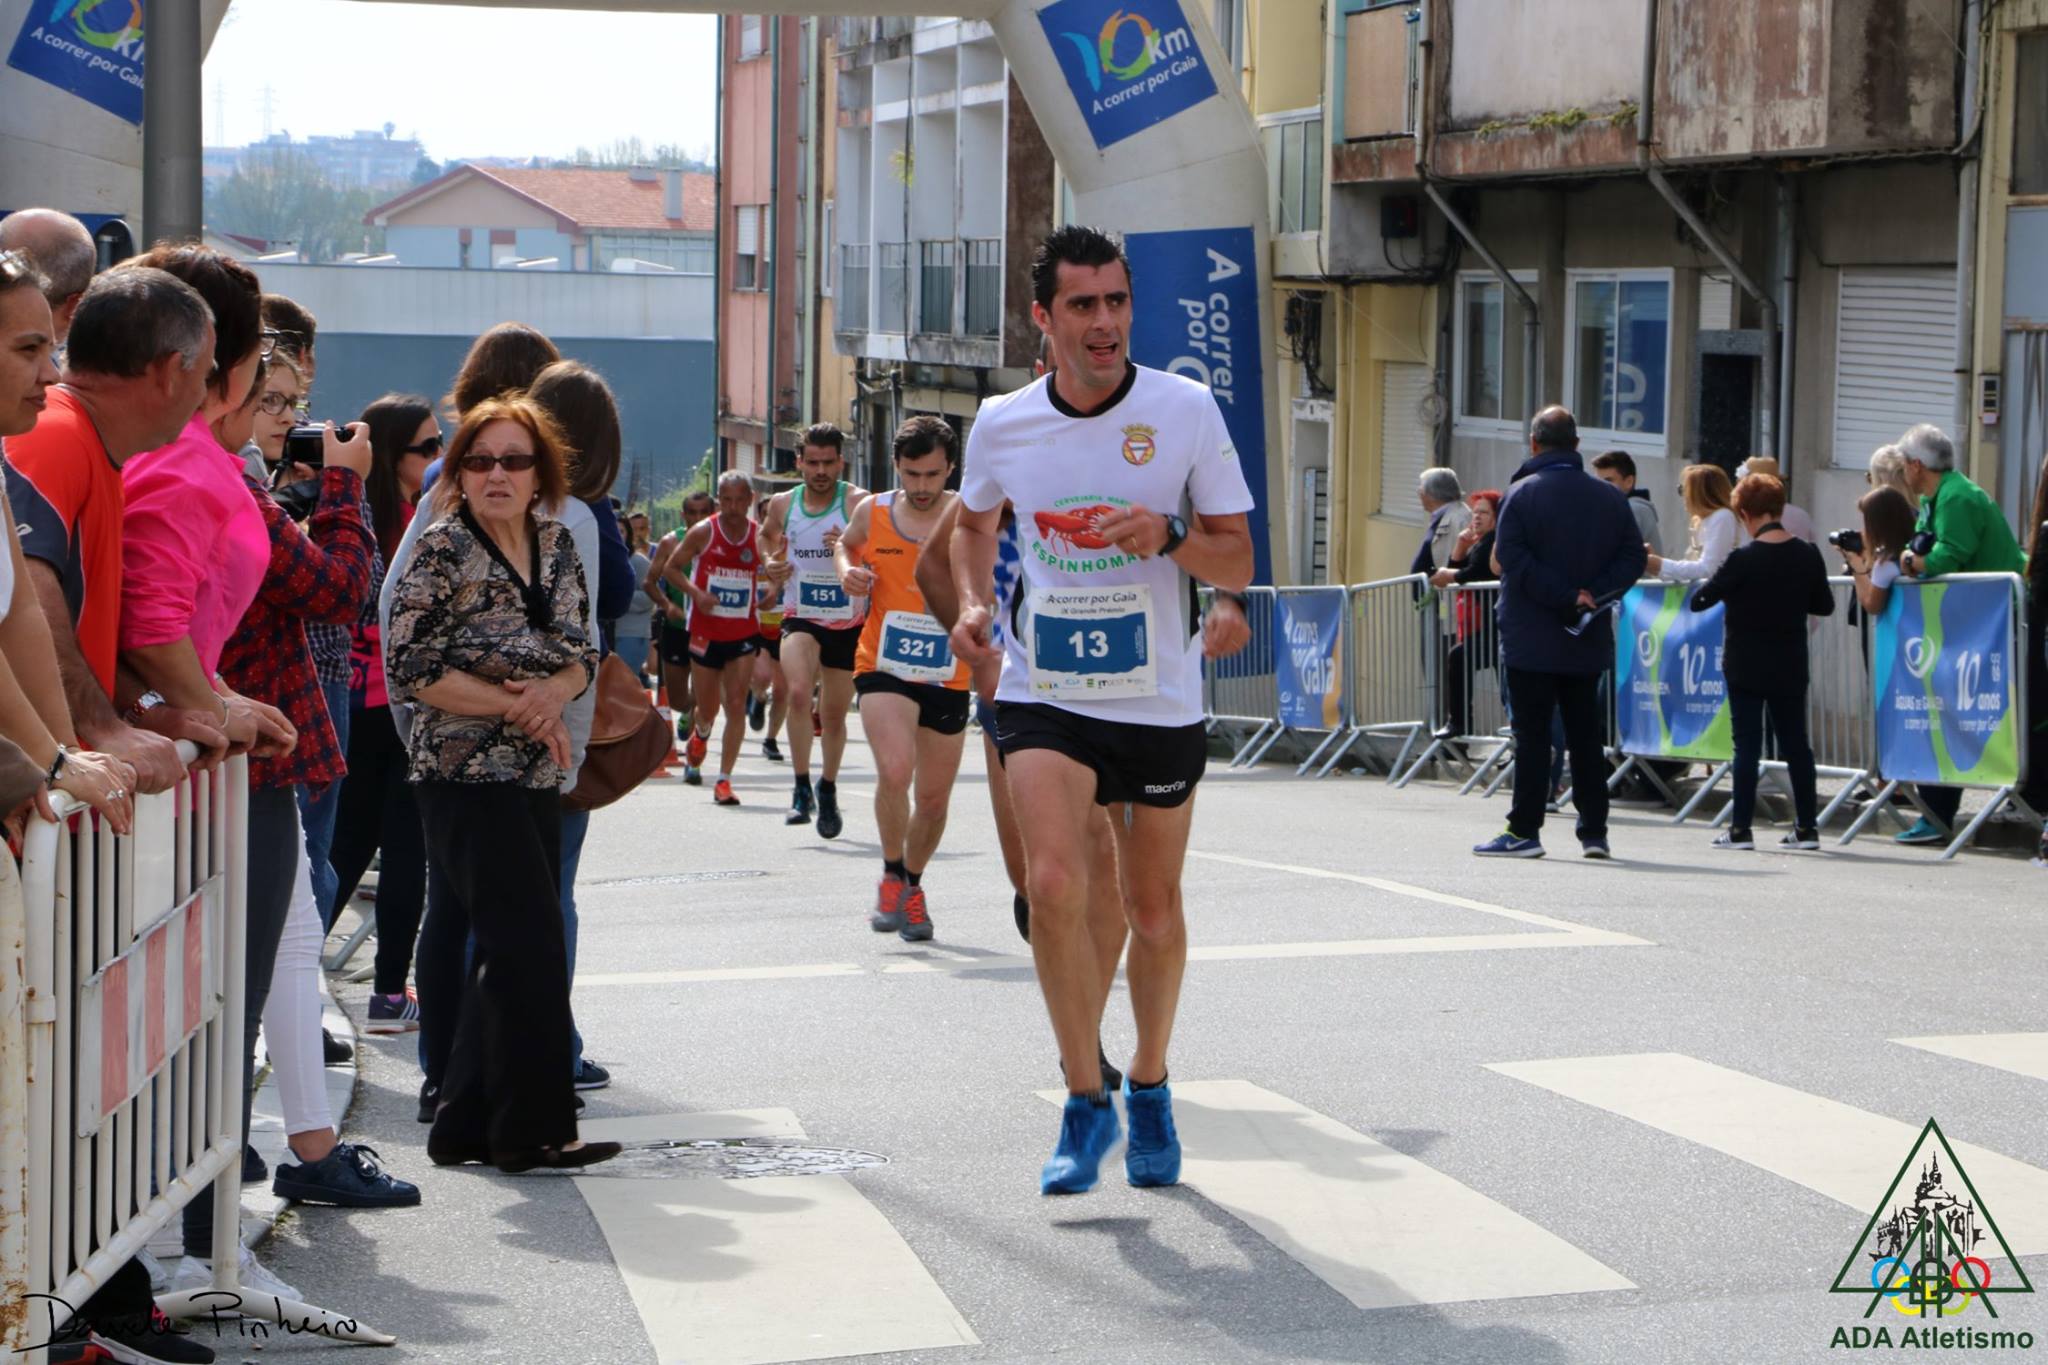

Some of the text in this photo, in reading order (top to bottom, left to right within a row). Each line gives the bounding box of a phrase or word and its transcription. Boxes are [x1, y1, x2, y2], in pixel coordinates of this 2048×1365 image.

[31, 26, 43, 41] A
[44, 33, 92, 61] correr
[88, 55, 119, 74] por
[1092, 55, 1199, 115] A correr por Gaia
[1177, 298, 1208, 355] por
[1206, 247, 1241, 405] A correr
[1031, 540, 1138, 573] ESPINHOMA
[718, 591, 740, 604] 179
[810, 589, 837, 602] 151
[1056, 594, 1090, 604] correr
[1090, 594, 1109, 606] por
[1112, 592, 1137, 603] Gaia
[897, 638, 936, 659] 321
[1068, 630, 1109, 659] 13
[1679, 643, 1706, 695] 10
[1955, 650, 1981, 711] 10
